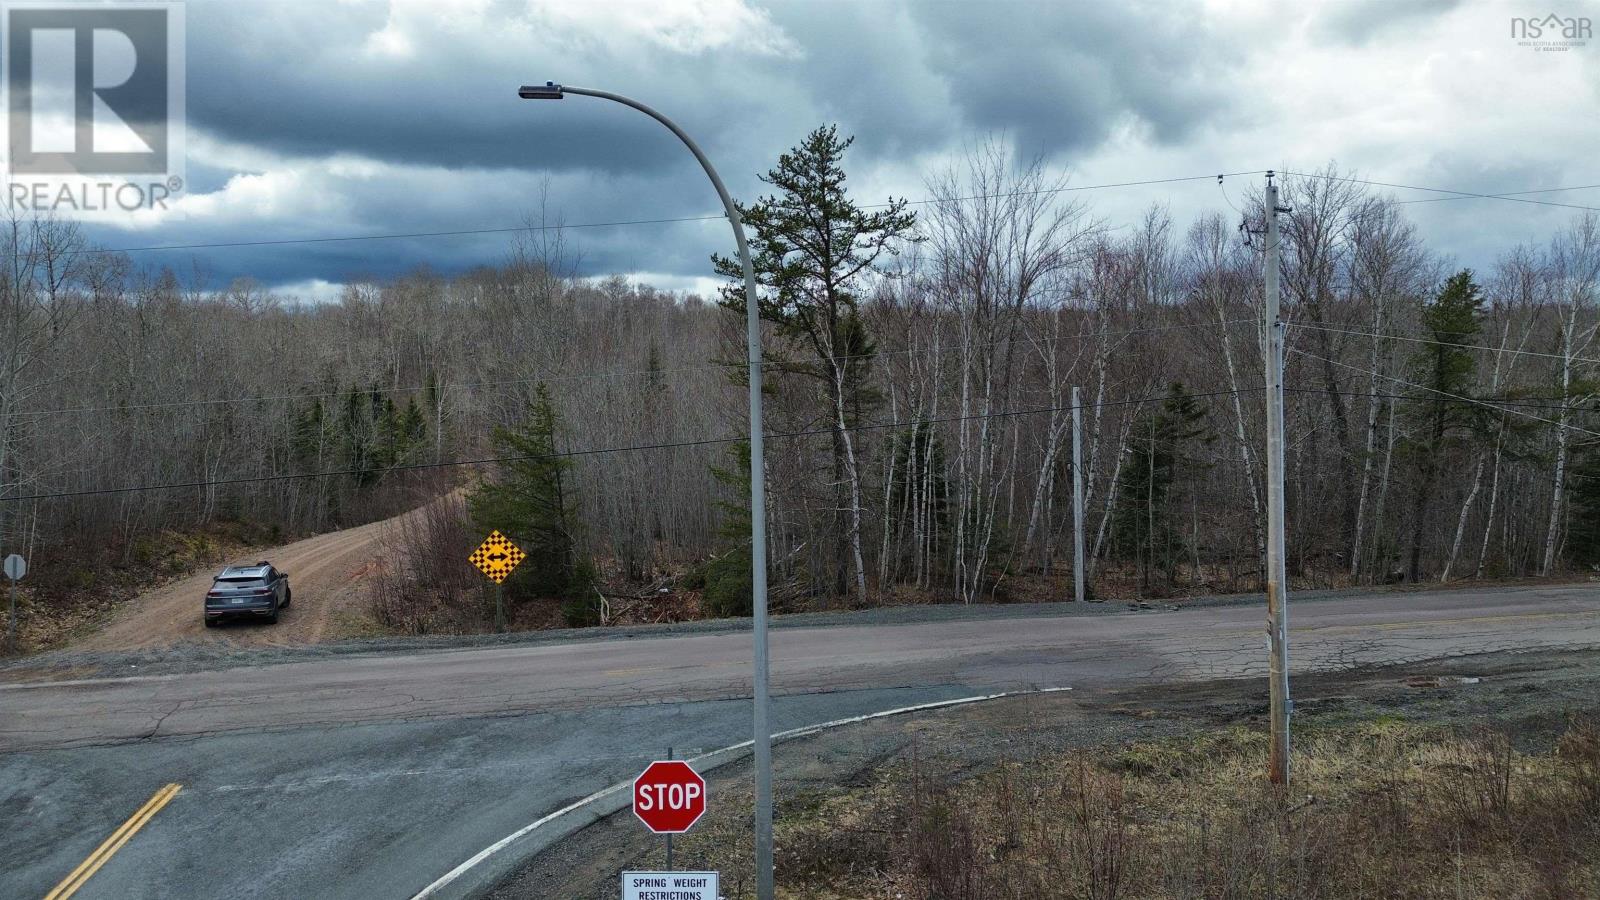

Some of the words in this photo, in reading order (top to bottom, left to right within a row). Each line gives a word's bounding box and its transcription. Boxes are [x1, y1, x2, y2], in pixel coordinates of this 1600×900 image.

[639, 783, 701, 811] STOP
[633, 878, 667, 888] SPRING
[673, 878, 708, 888] WEIGHT
[638, 891, 702, 900] RESTRICTIONS
